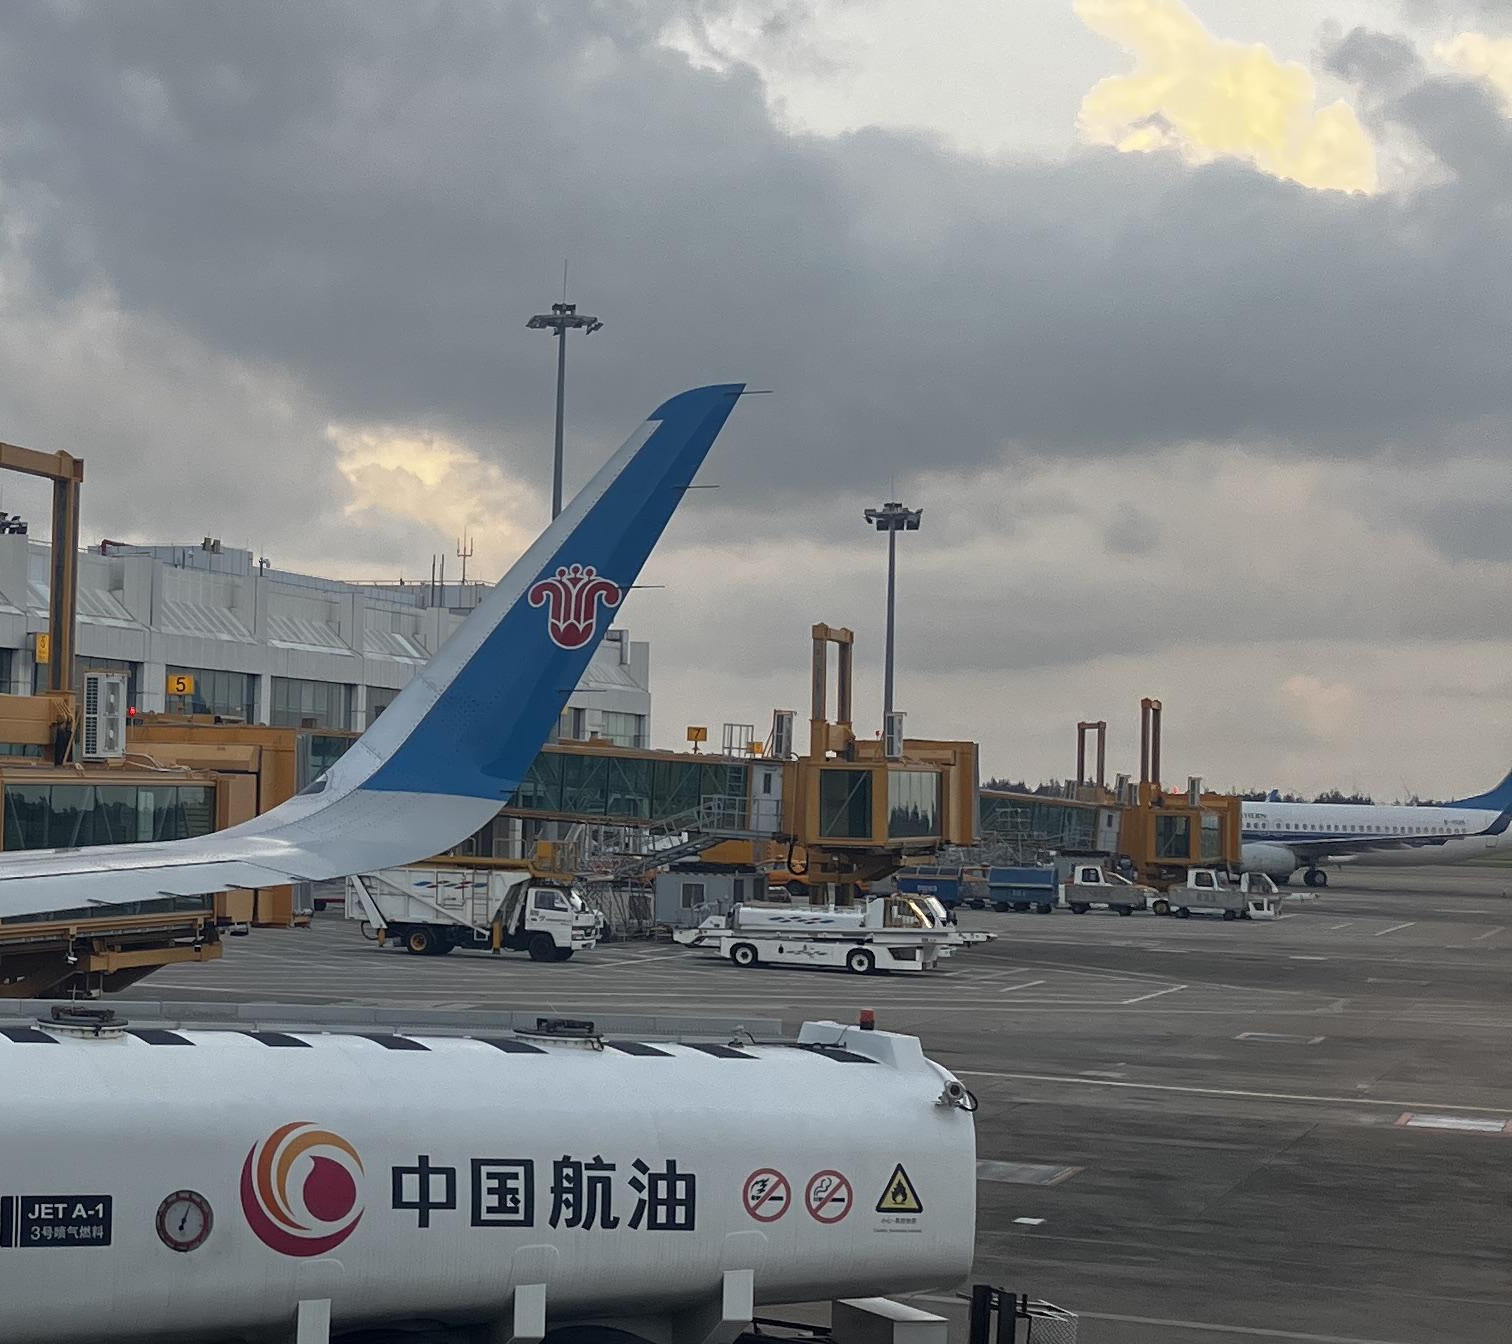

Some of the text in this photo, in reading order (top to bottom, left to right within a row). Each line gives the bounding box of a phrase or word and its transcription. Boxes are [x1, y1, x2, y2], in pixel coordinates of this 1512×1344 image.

[175, 676, 186, 693] 5
[391, 1154, 696, 1232] 中国航油
[28, 1202, 104, 1220] JET A-1
